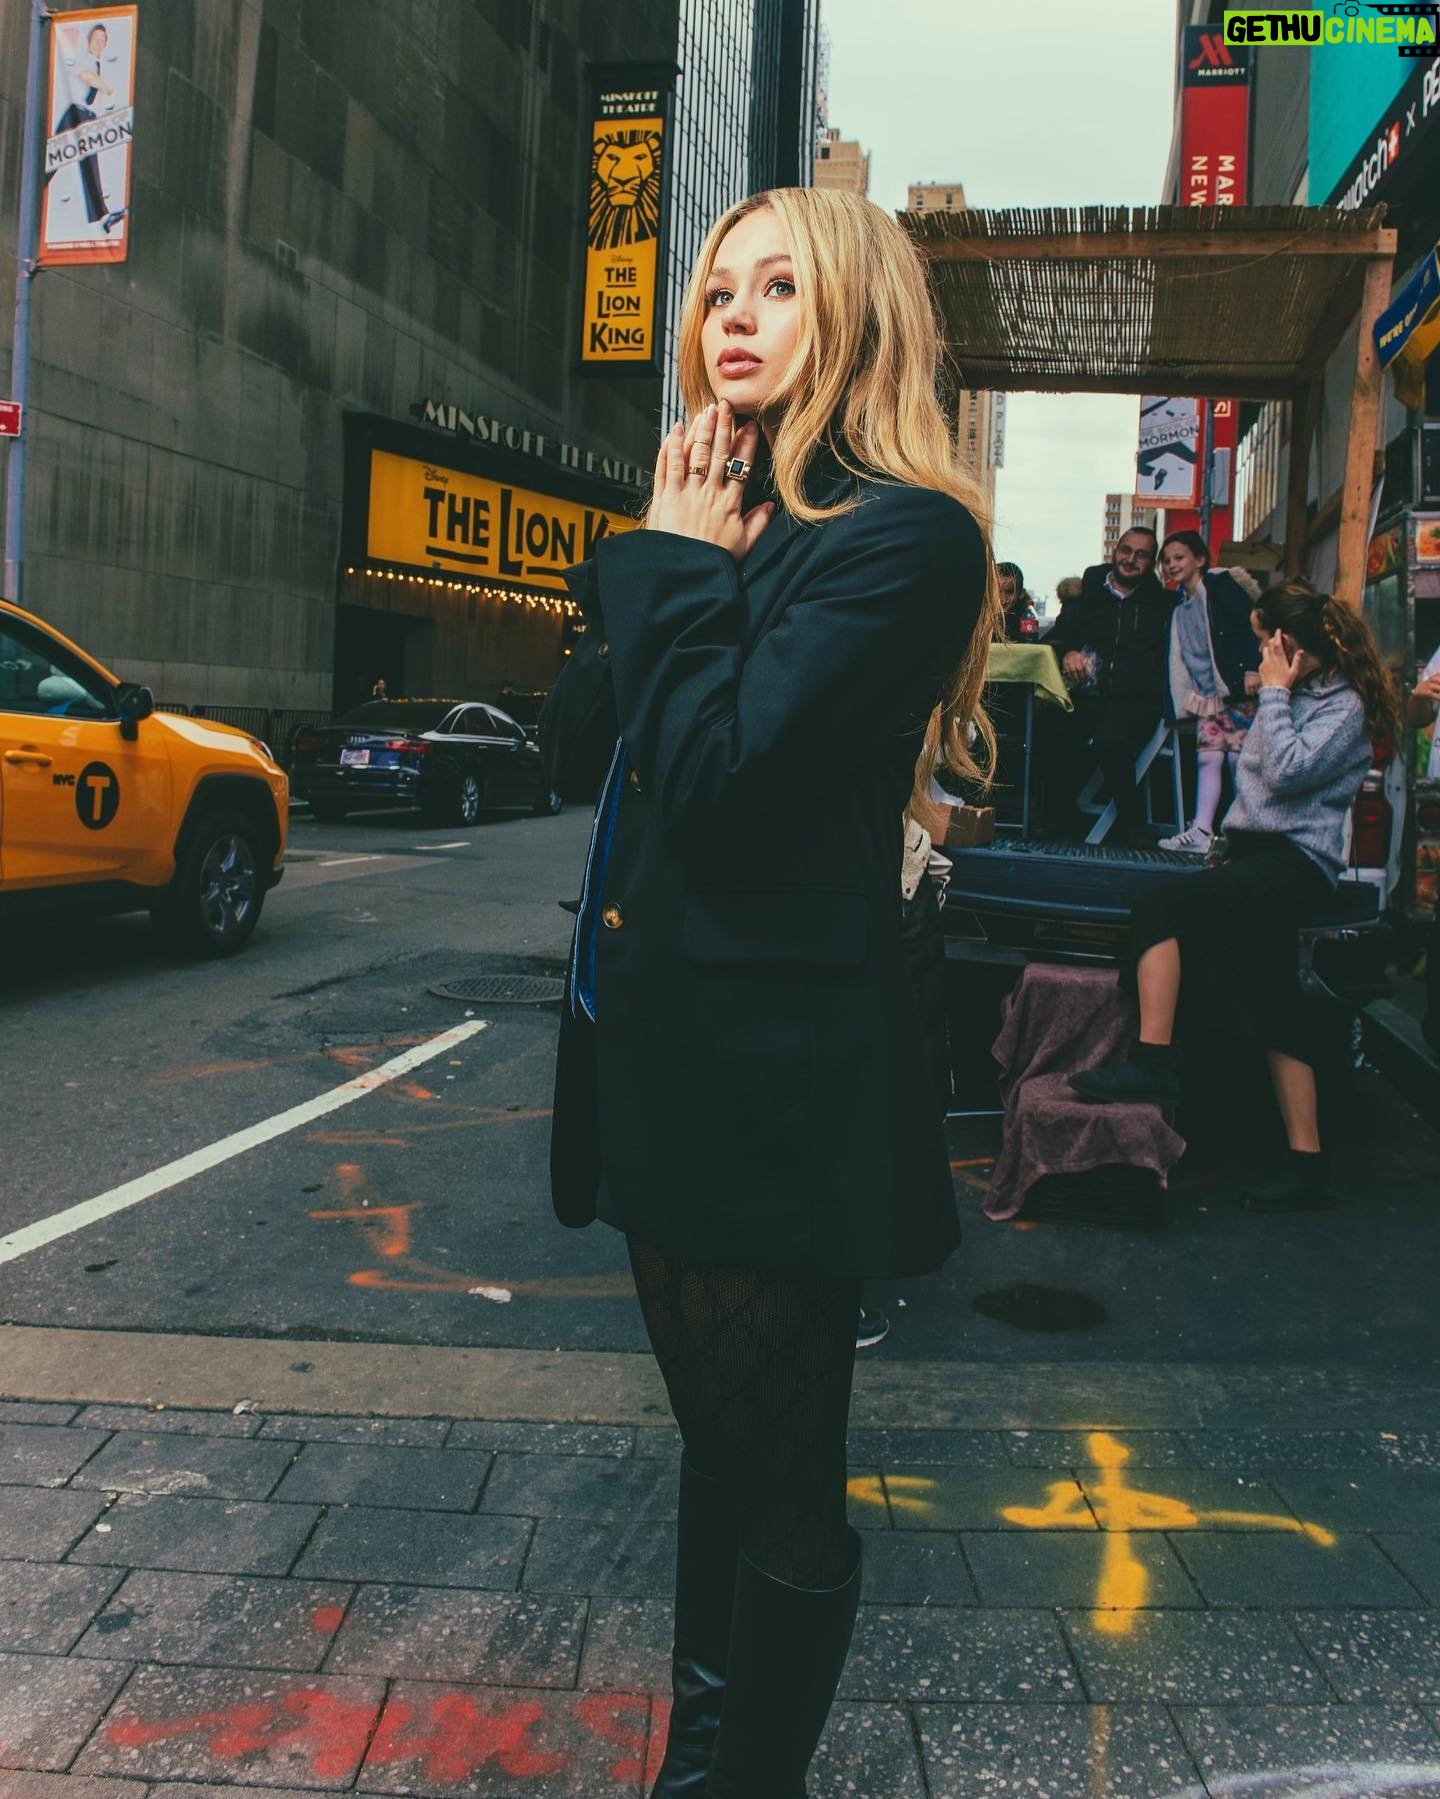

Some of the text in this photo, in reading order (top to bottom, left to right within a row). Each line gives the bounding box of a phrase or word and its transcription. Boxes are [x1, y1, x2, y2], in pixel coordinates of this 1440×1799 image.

[1198, 68, 1246, 77] MARRIOTT
[601, 90, 658, 102] MINSKOFF
[602, 103, 655, 114] THEATRE
[48, 121, 133, 166] MORMON
[604, 267, 637, 283] THE
[597, 290, 641, 319] LION
[590, 322, 645, 353] KING
[421, 399, 547, 458] MINSKOFF
[1139, 425, 1199, 449] MORMON
[423, 465, 448, 487] Disney
[424, 486, 490, 548] THE
[498, 487, 576, 577] LION
[53, 773, 75, 786] NYC
